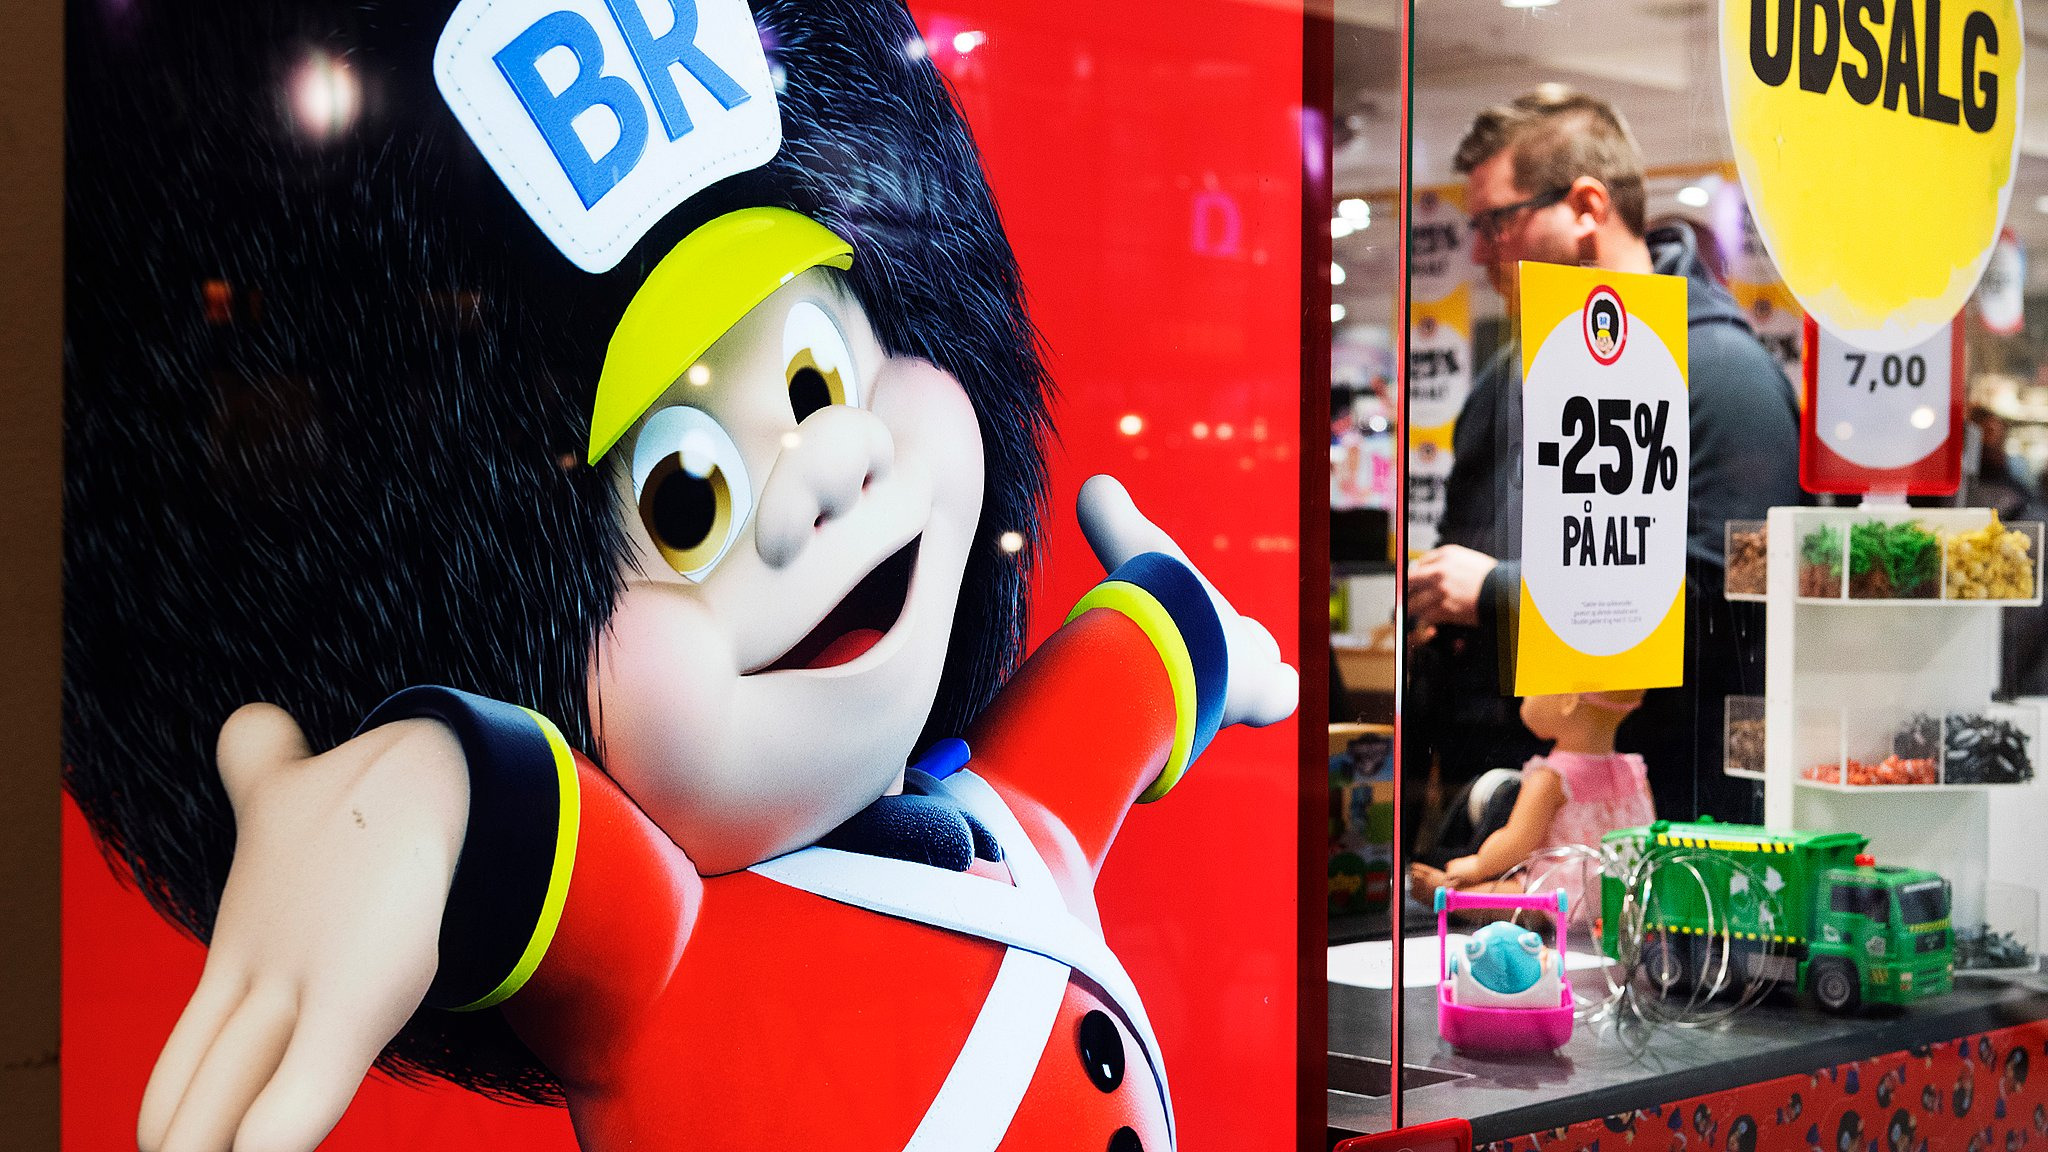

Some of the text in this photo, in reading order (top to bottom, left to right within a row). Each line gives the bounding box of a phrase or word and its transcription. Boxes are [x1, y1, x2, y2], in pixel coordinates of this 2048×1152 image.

[492, 0, 752, 211] BR
[1750, 0, 1999, 133] UDSALG
[1845, 354, 1927, 392] 7,00
[1538, 396, 1678, 495] -25%
[1563, 500, 1597, 566] PÅ
